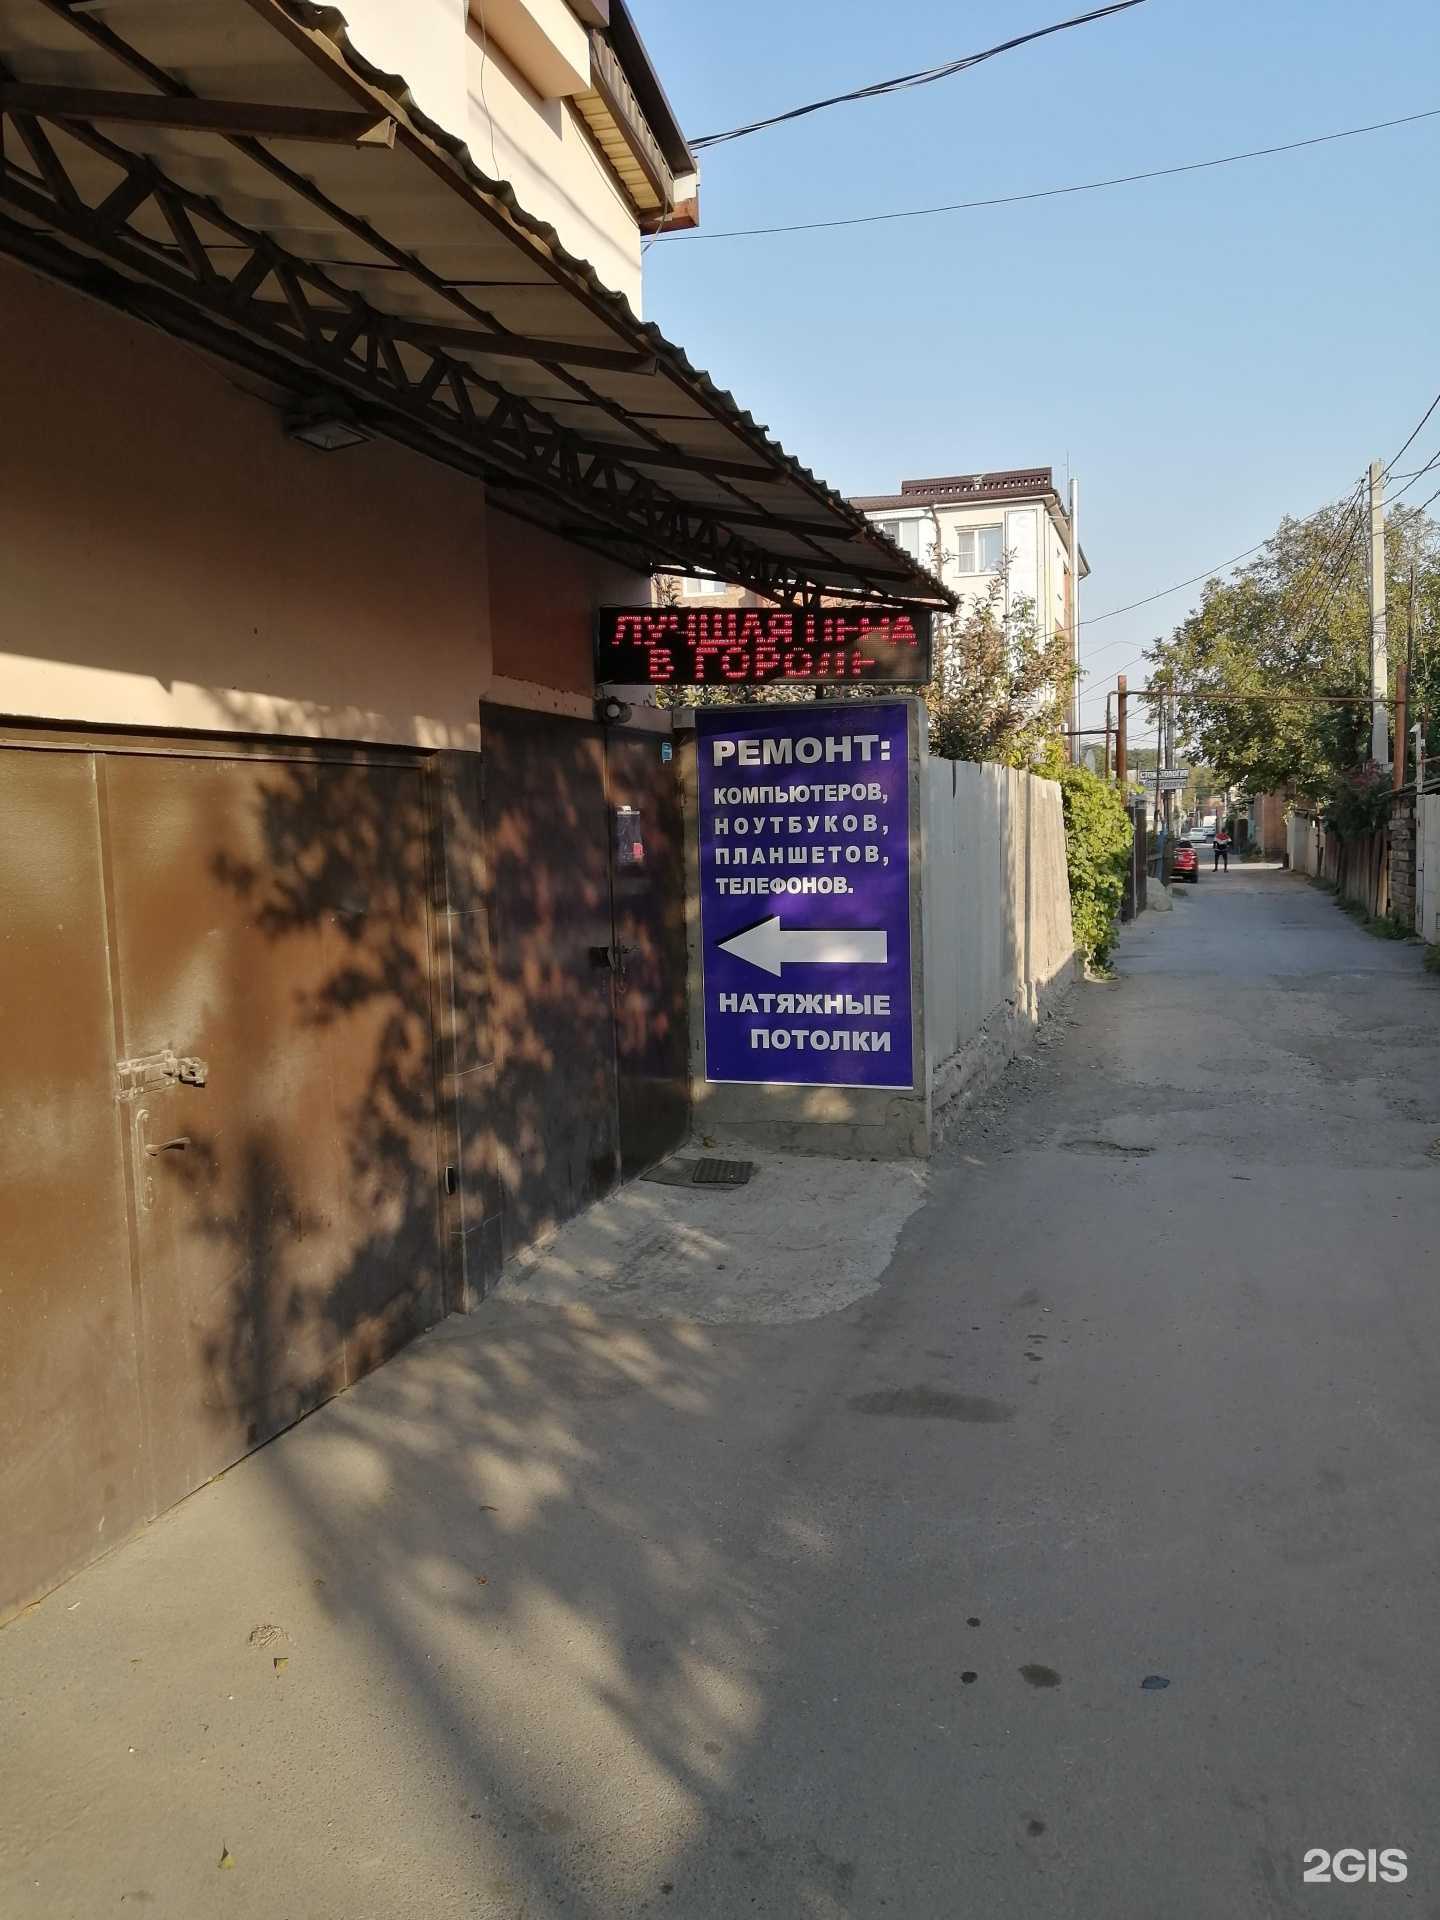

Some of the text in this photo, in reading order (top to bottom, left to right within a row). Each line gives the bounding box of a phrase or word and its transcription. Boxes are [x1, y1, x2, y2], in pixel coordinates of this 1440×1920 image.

[611, 613, 793, 647] ЛУЧШАЯ
[650, 649, 675, 680] В
[712, 734, 891, 767] РЕМОНТ:
[713, 782, 888, 805] КОМПЬЮТЕРОВ,
[714, 814, 889, 836] НОУТБУКОВ,
[715, 845, 889, 866] ПЛАНШЕТОВ,
[715, 876, 854, 895] ТЕЛЕФОНОВ.
[719, 993, 891, 1016] НАТЯЖНЫЕ
[750, 1028, 891, 1052] ПОТОЛКИ
